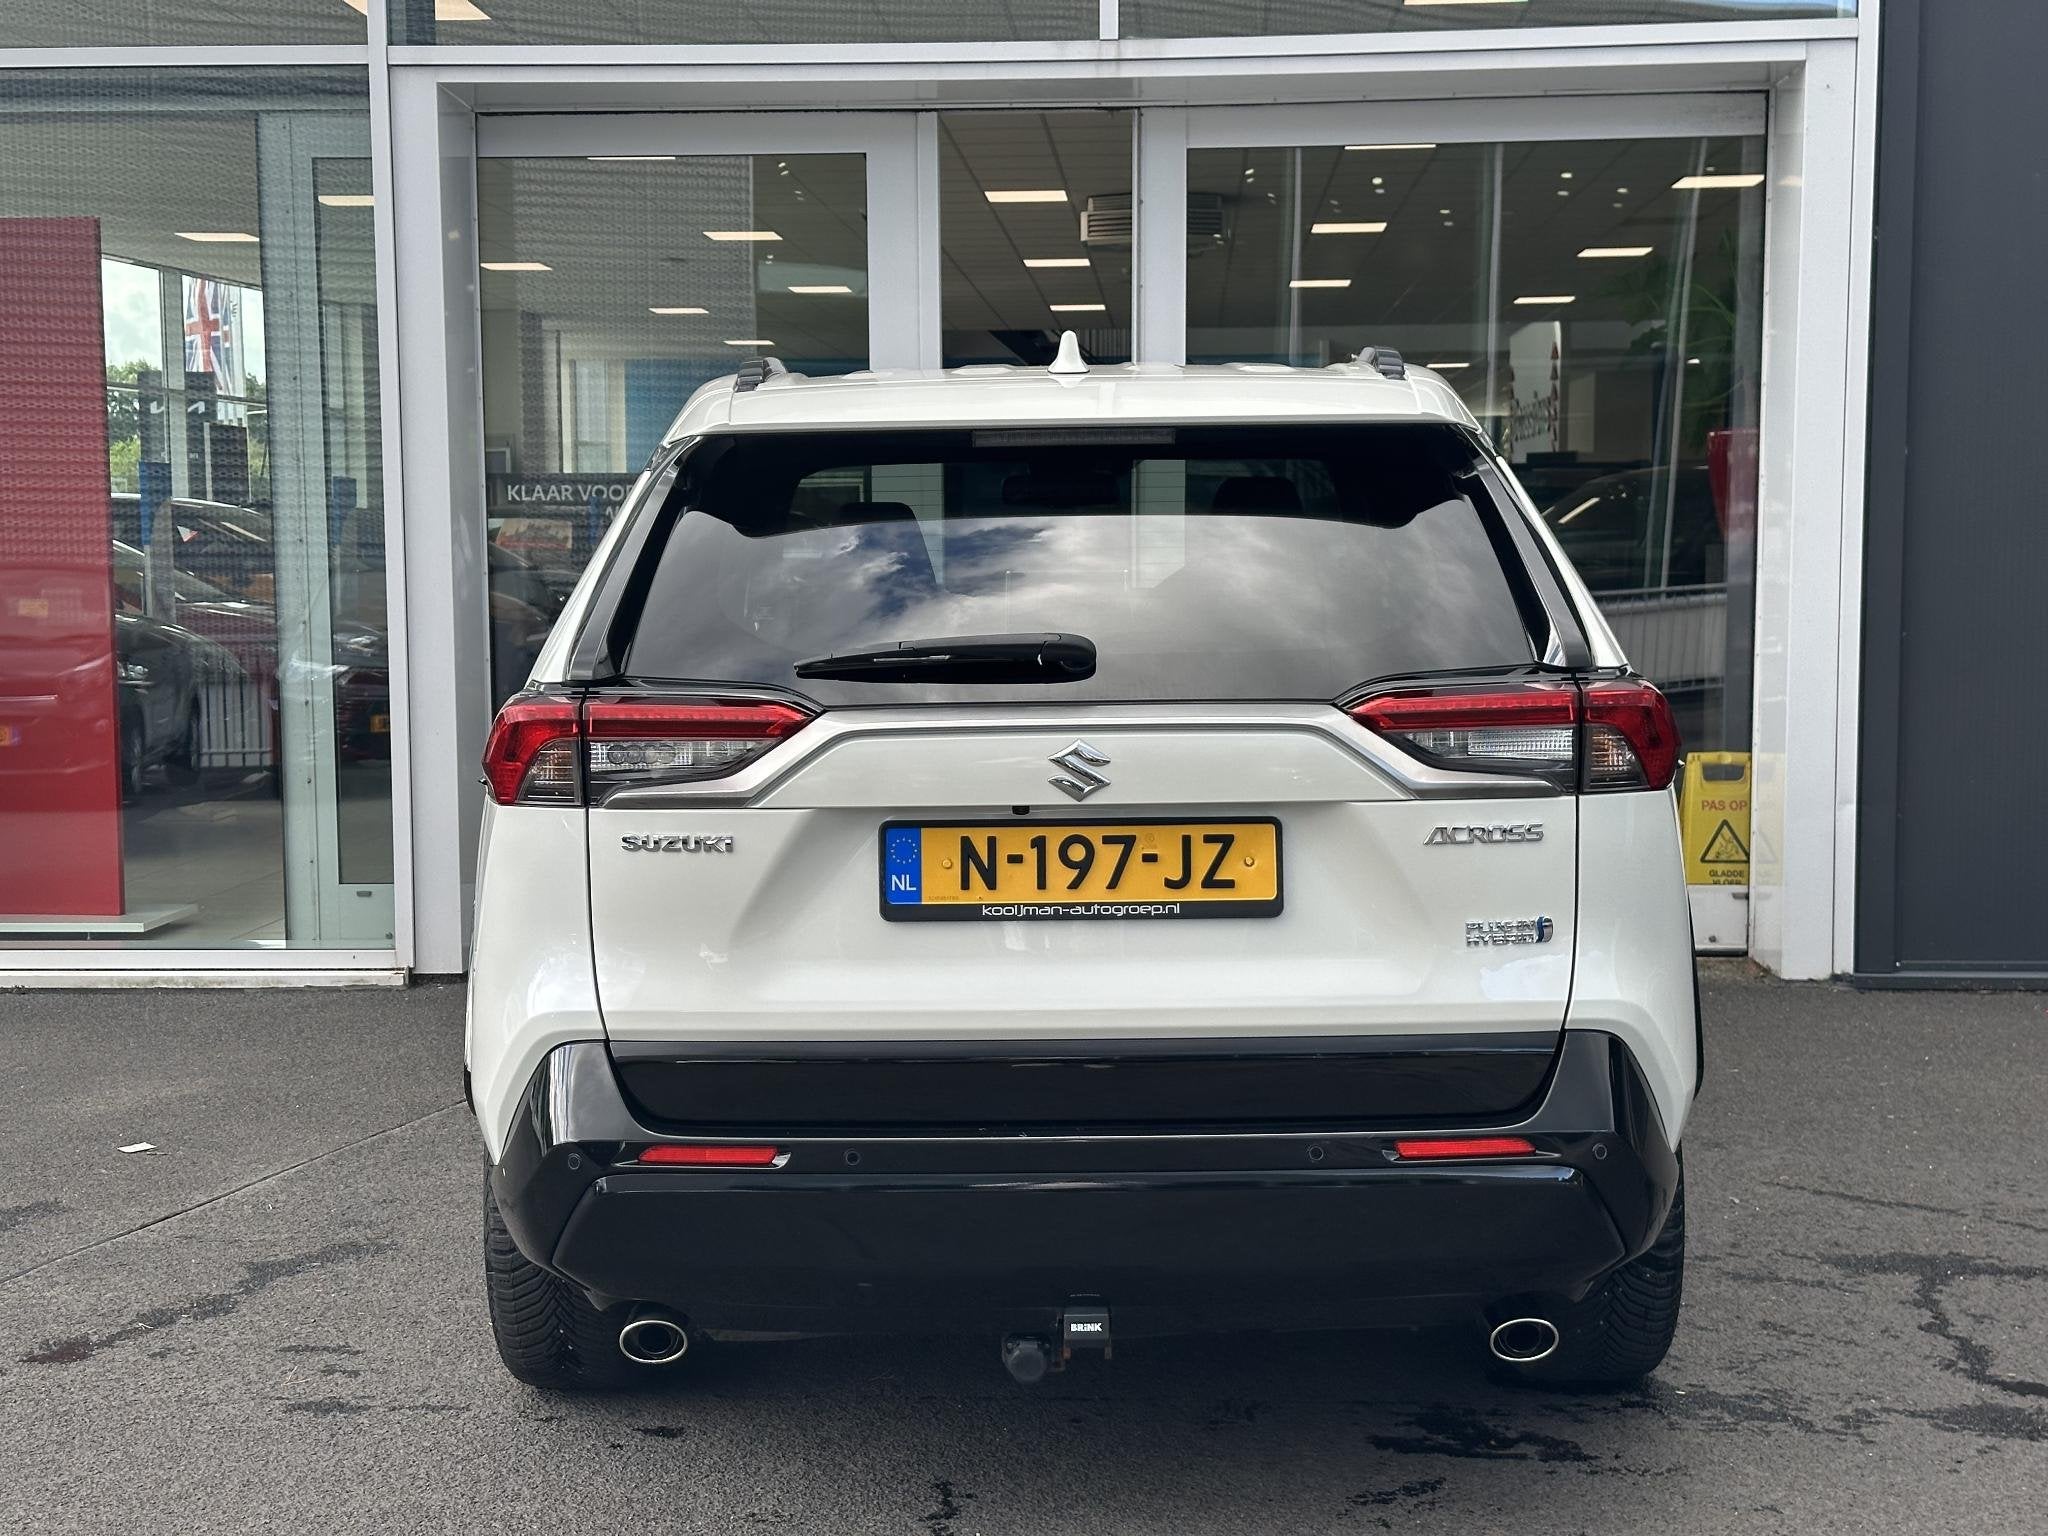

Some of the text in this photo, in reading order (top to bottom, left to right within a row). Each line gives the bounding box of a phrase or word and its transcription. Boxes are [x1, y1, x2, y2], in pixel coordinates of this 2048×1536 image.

[507, 484, 573, 501] KLAAR
[1702, 800, 1748, 811] PAS OP
[621, 832, 734, 853] SUZUKI
[1423, 823, 1545, 845] ACROSS
[960, 833, 1236, 891] N-197-JZ
[1708, 869, 1745, 878] GLADDE
[891, 874, 917, 891] NL
[1466, 918, 1536, 934] PLUG-IN
[1466, 932, 1536, 947] HYBRID
